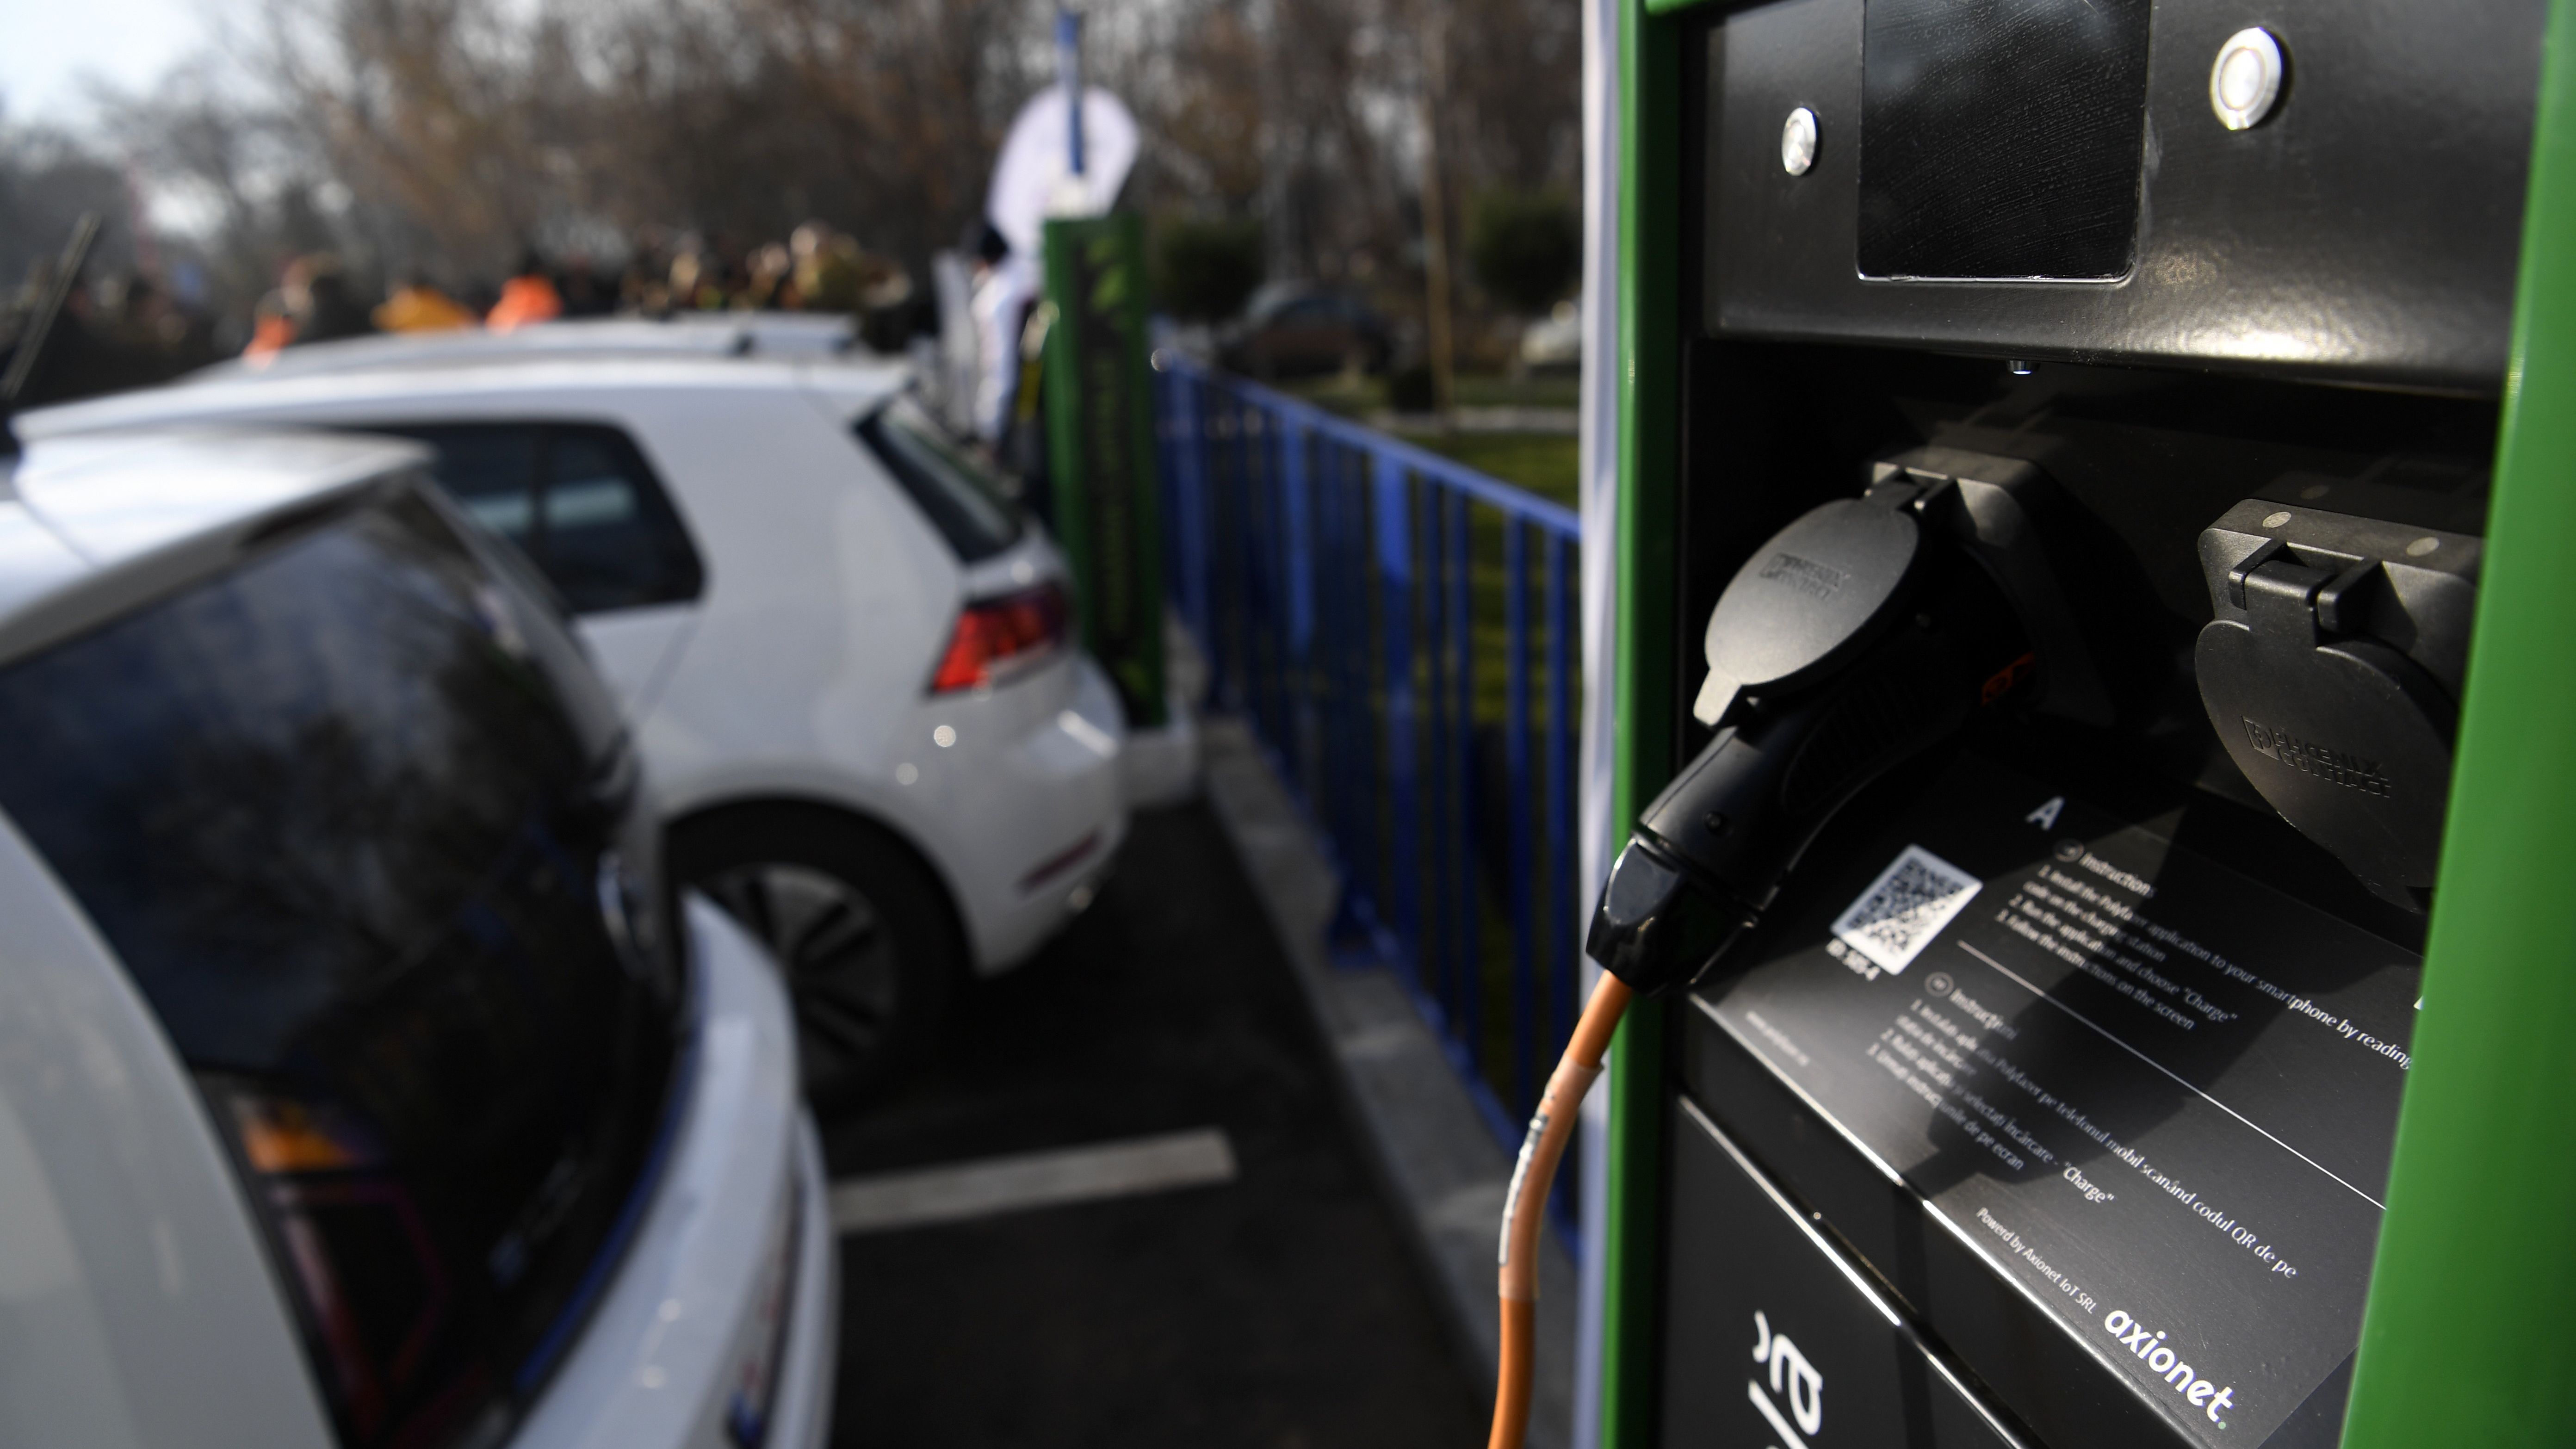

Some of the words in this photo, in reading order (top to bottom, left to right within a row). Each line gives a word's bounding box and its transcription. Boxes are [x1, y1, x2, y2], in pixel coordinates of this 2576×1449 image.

[2026, 798, 2062, 829] A
[2080, 853, 2154, 898] Instructions
[2059, 924, 2116, 959] application
[2115, 957, 2141, 972] and
[2137, 968, 2179, 993] choose
[2184, 987, 2237, 1022] "Charge"
[2126, 936, 2166, 961] station
[2056, 946, 2117, 985] instructions
[2117, 982, 2134, 995] on
[2134, 989, 2155, 1005] the
[2154, 1003, 2194, 1029] screen
[2147, 924, 2211, 960] application
[2211, 954, 2226, 968] to
[2224, 964, 2255, 983] your
[2256, 980, 2337, 1026] smartphone
[2336, 1019, 2358, 1038] by
[2357, 1033, 2413, 1069] reading
[1963, 1121, 1980, 1135] de
[1976, 1132, 1994, 1146] pe
[1992, 1143, 2024, 1170] ecran
[2038, 1093, 2057, 1105] pe
[2056, 1102, 2110, 1143] telefonul
[2105, 1139, 2144, 1168] mobil
[2192, 1201, 2235, 1231] codul
[2231, 1226, 2256, 1248] QR
[2254, 1245, 2275, 1260] de
[2271, 1259, 2296, 1278] pe
[2062, 1161, 2114, 1203] "Charge"
[1976, 1208, 2015, 1241] Powerd
[2009, 1236, 2025, 1253] by
[2022, 1248, 2061, 1282] Axionet
[2059, 1278, 2080, 1296] IoT
[2075, 1292, 2096, 1314] SRL
